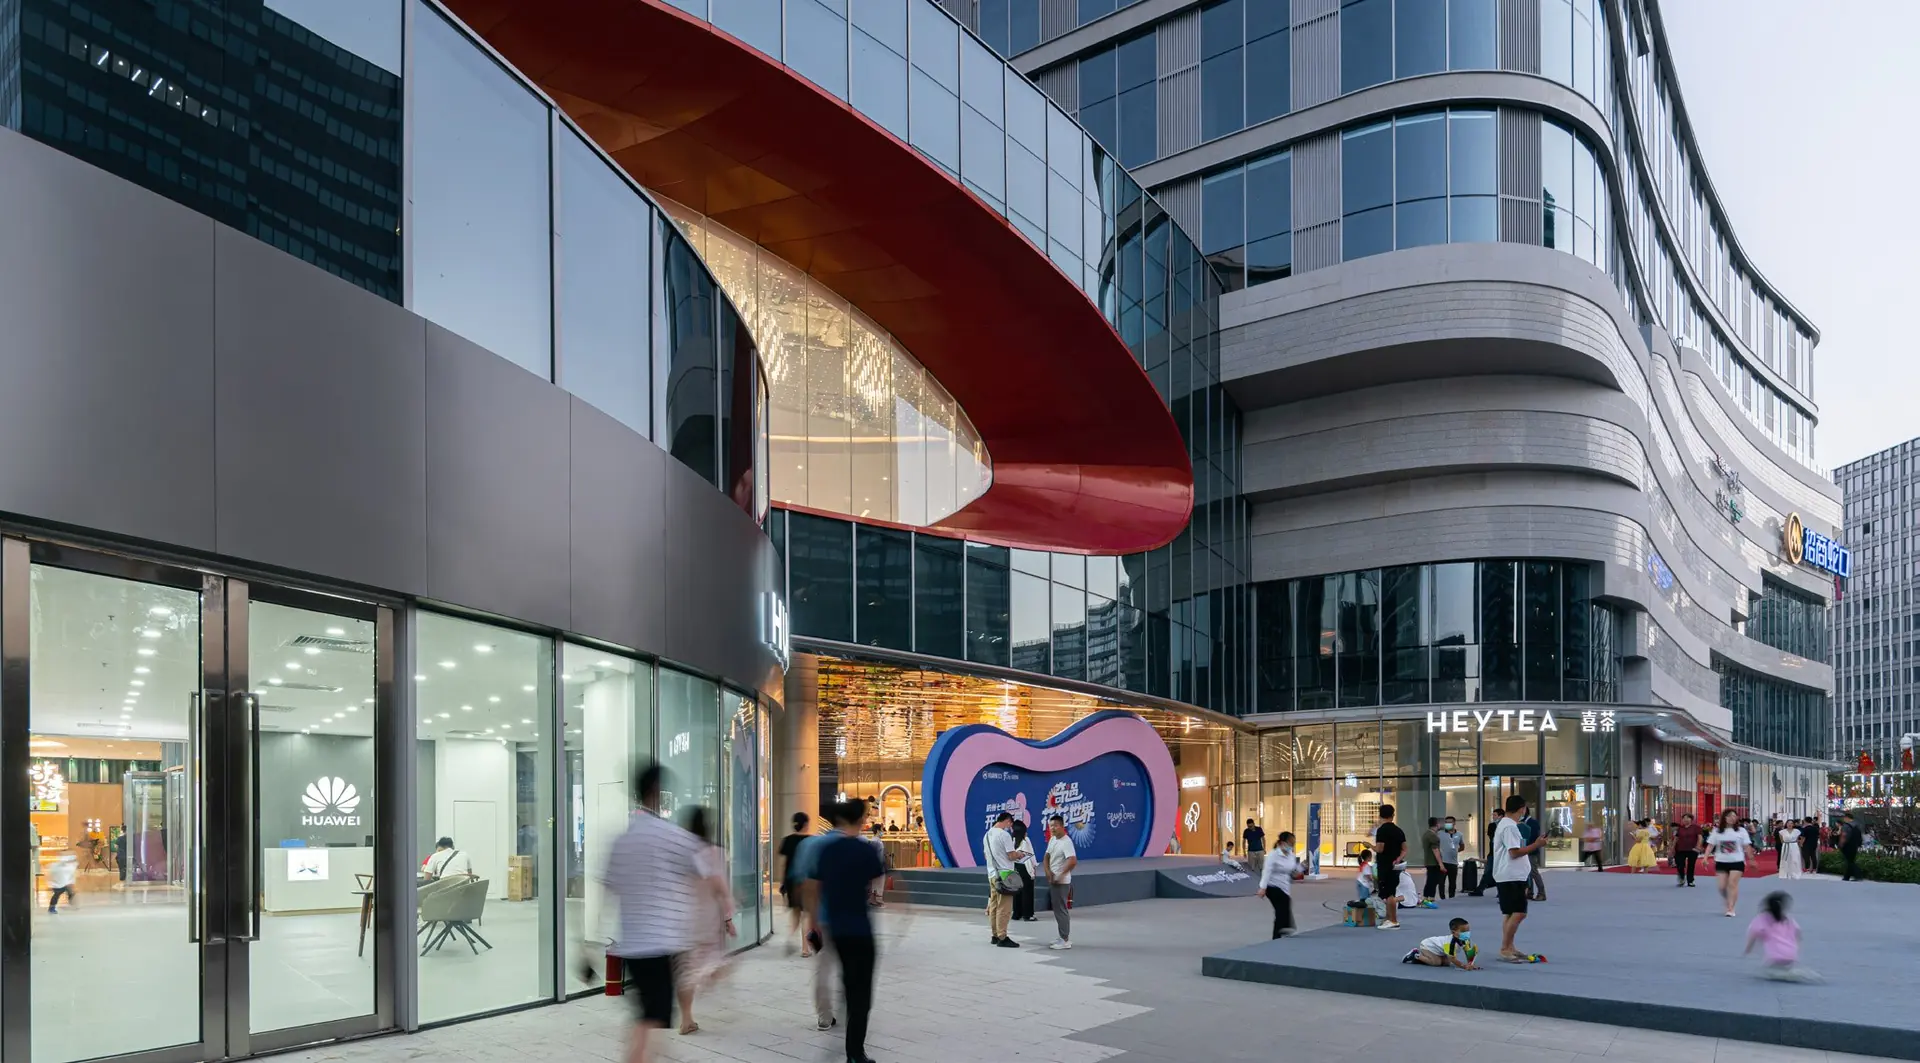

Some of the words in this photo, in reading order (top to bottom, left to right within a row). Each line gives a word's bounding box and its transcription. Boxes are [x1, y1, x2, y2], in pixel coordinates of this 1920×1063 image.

[1804, 528, 1850, 578] 招商蛇口
[1427, 710, 1558, 733] HEYTEA
[1581, 711, 1616, 733] 喜茶
[302, 816, 360, 826] HUAWEI
